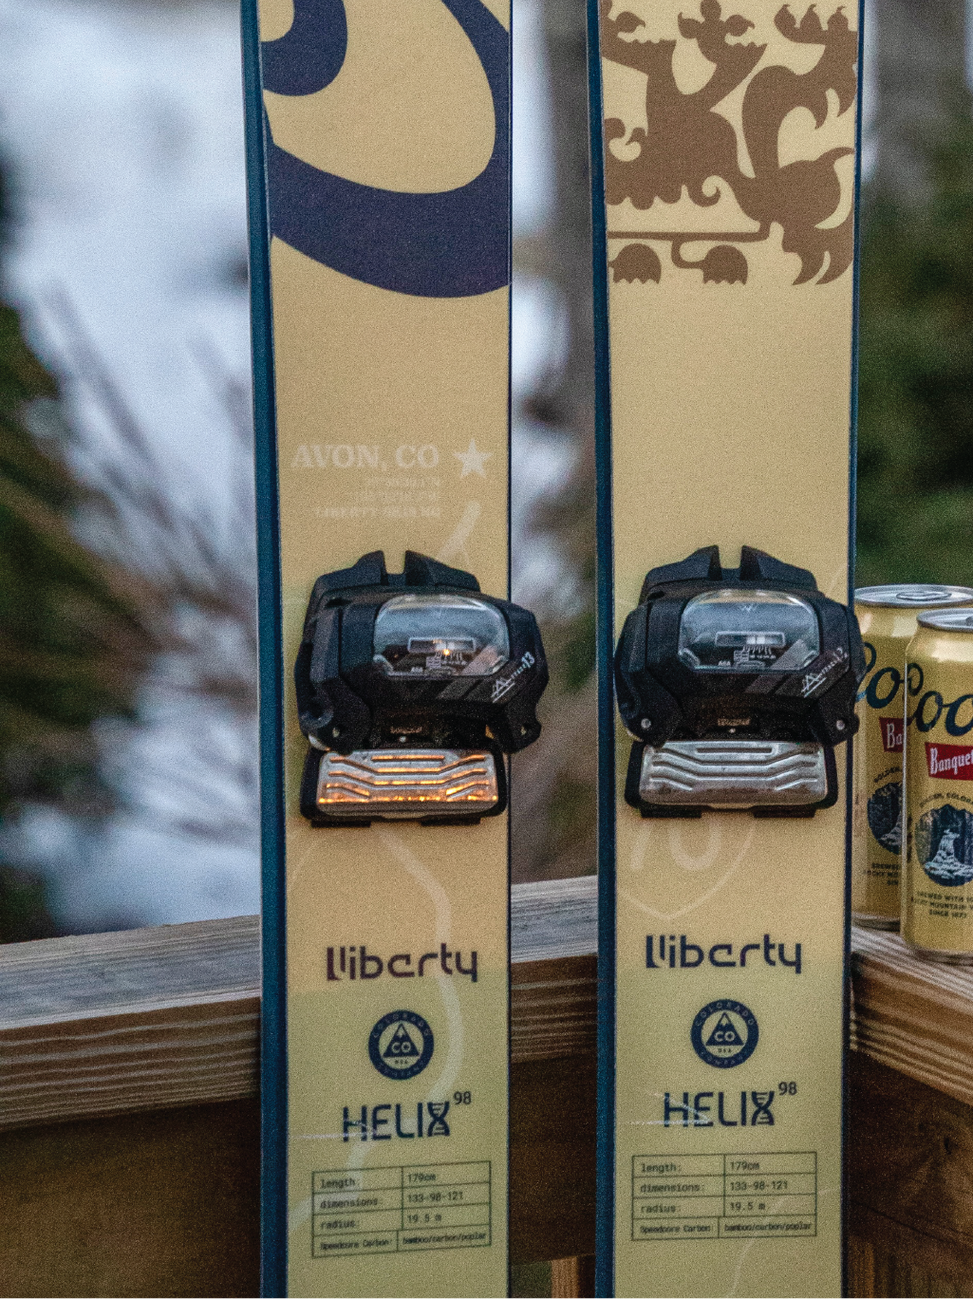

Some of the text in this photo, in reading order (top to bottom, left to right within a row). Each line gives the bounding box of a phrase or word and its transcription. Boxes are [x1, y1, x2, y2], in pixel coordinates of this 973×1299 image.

[395, 444, 441, 469] CO
[391, 1041, 411, 1054] CO
[713, 1030, 737, 1042] CO
[342, 1091, 472, 1143] HELIX 98
[663, 1081, 797, 1128] HELIX 98
